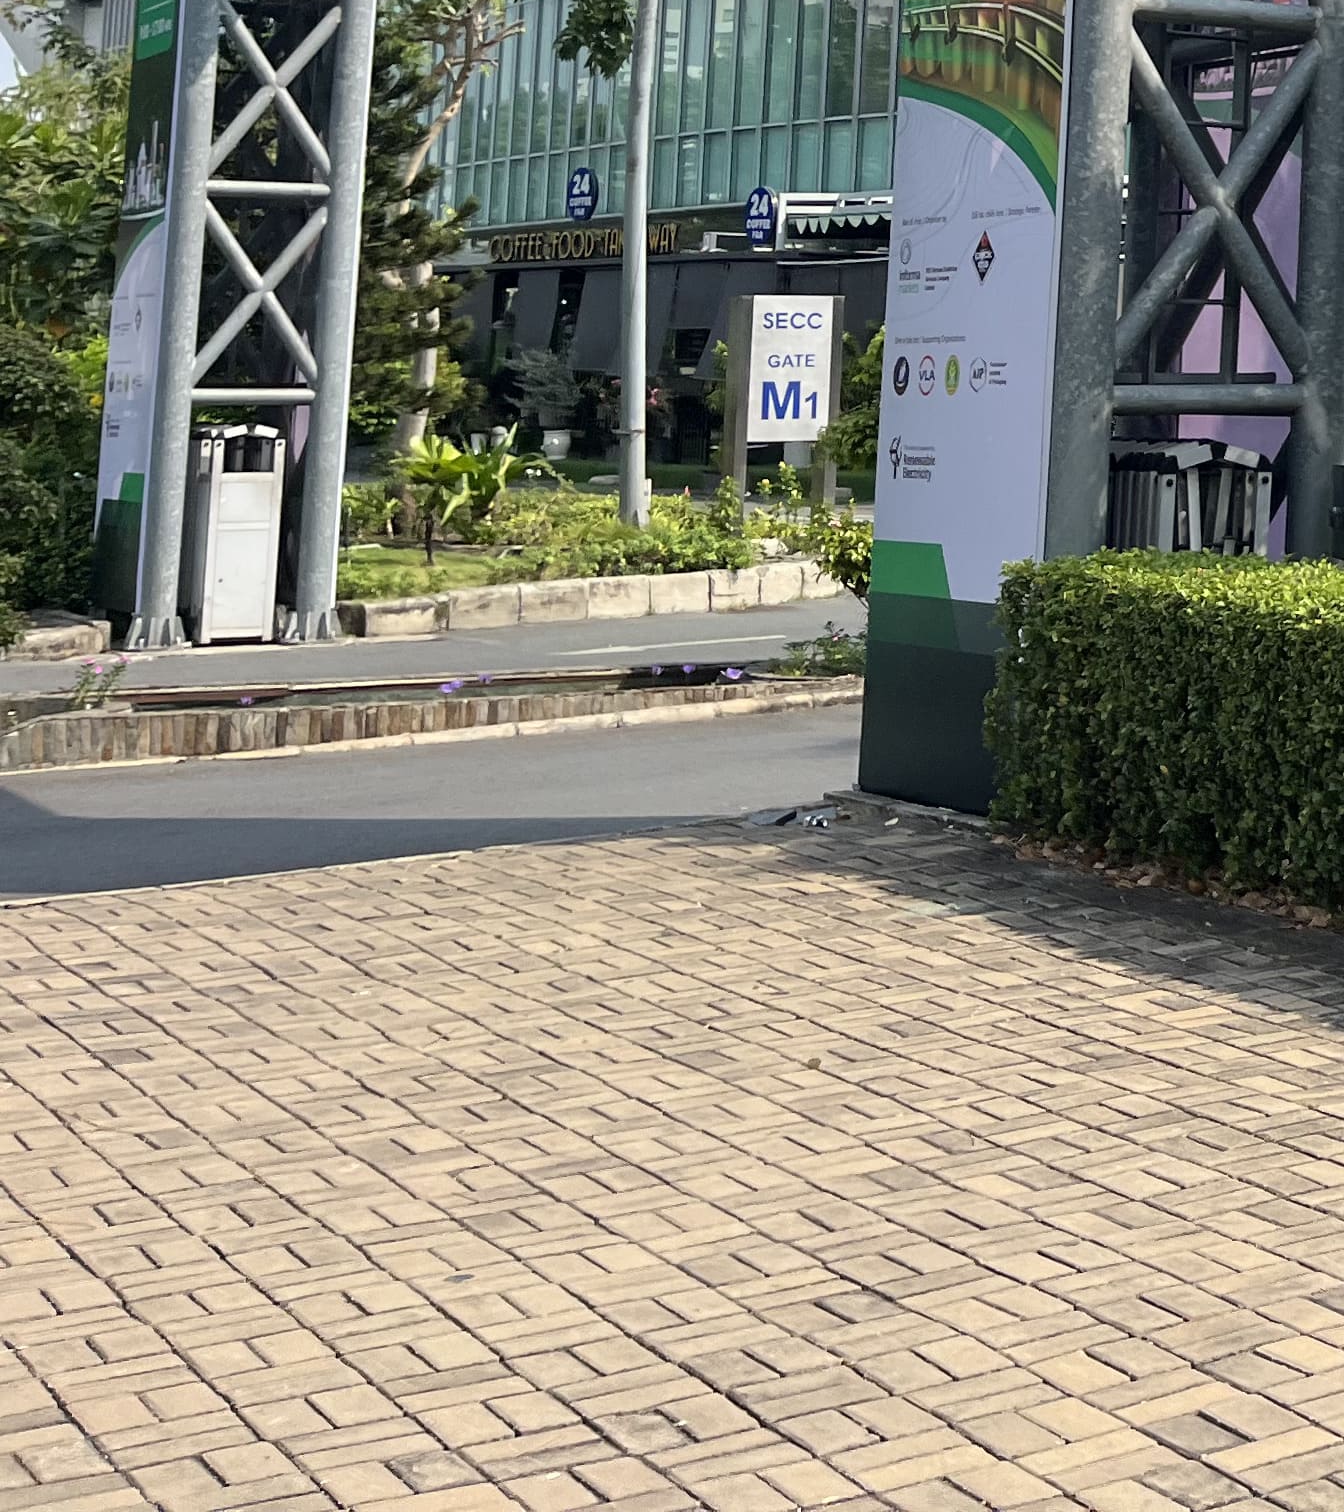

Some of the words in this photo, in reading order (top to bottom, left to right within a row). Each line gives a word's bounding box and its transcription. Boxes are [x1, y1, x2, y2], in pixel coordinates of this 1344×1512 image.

[572, 173, 590, 194] 24
[750, 193, 769, 216] 24
[489, 232, 544, 262] COFFEE
[552, 230, 595, 259] FOOD
[763, 312, 823, 330] SECC
[768, 354, 816, 368] GATE
[919, 369, 935, 381] VLA
[760, 381, 817, 421] M1
